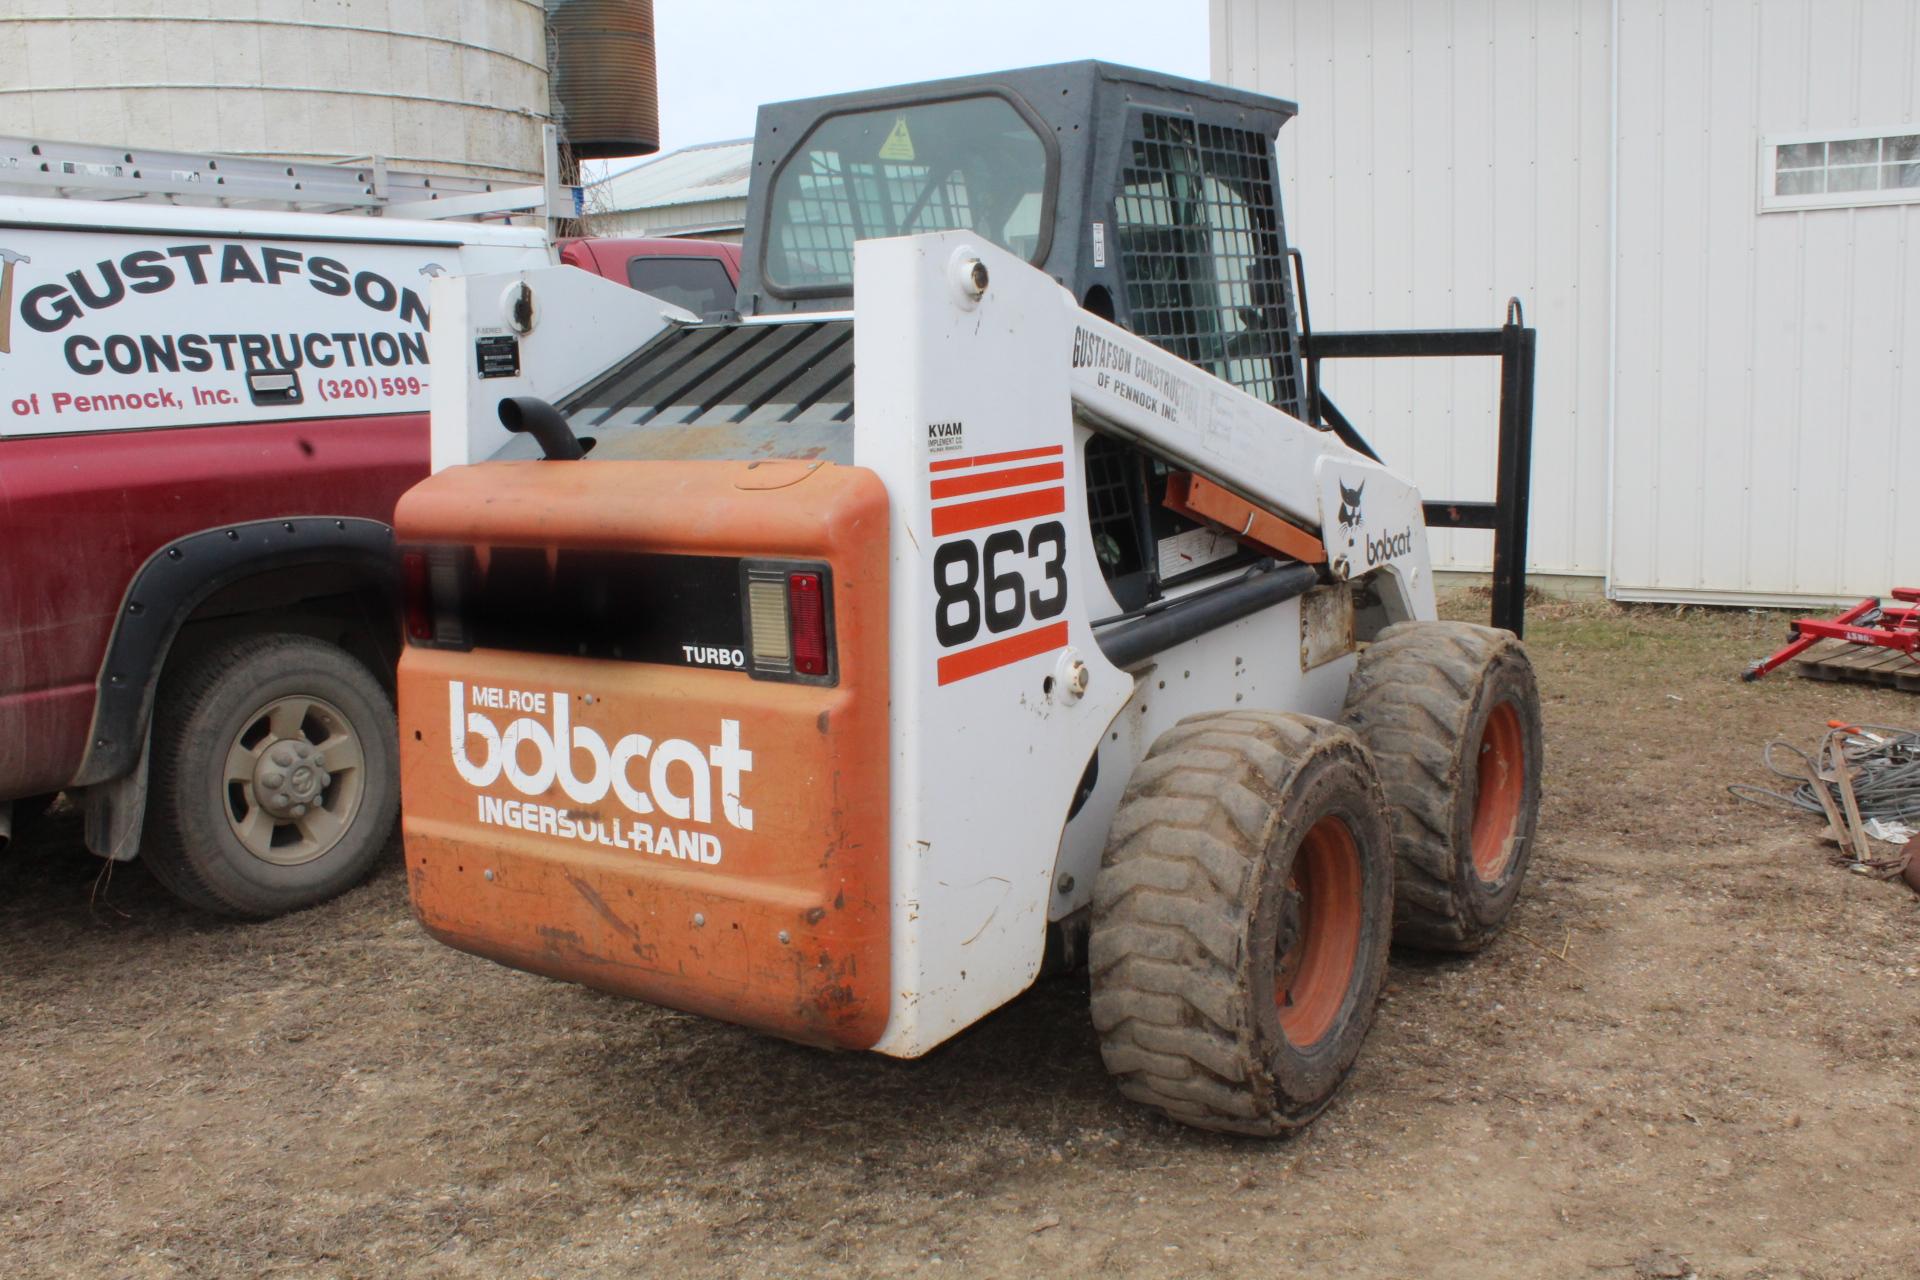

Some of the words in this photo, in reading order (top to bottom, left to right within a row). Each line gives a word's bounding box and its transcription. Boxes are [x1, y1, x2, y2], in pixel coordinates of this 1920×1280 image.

[20, 244, 430, 333] GUSTAFSON
[63, 331, 430, 375] CONSTRUCTION
[1072, 325, 1132, 374] GUSTAFSON
[11, 391, 40, 416] of
[52, 386, 184, 414] Pennock,
[193, 385, 239, 407] Inc.
[1097, 372, 1111, 389] OF
[1114, 380, 1158, 413] PENNOCK
[928, 422, 962, 438] KVAM
[1366, 525, 1411, 566] bobcat
[933, 520, 1068, 648] 863
[682, 645, 745, 667] TURBO
[472, 685, 546, 715] MELROE
[449, 680, 753, 831] bobcat
